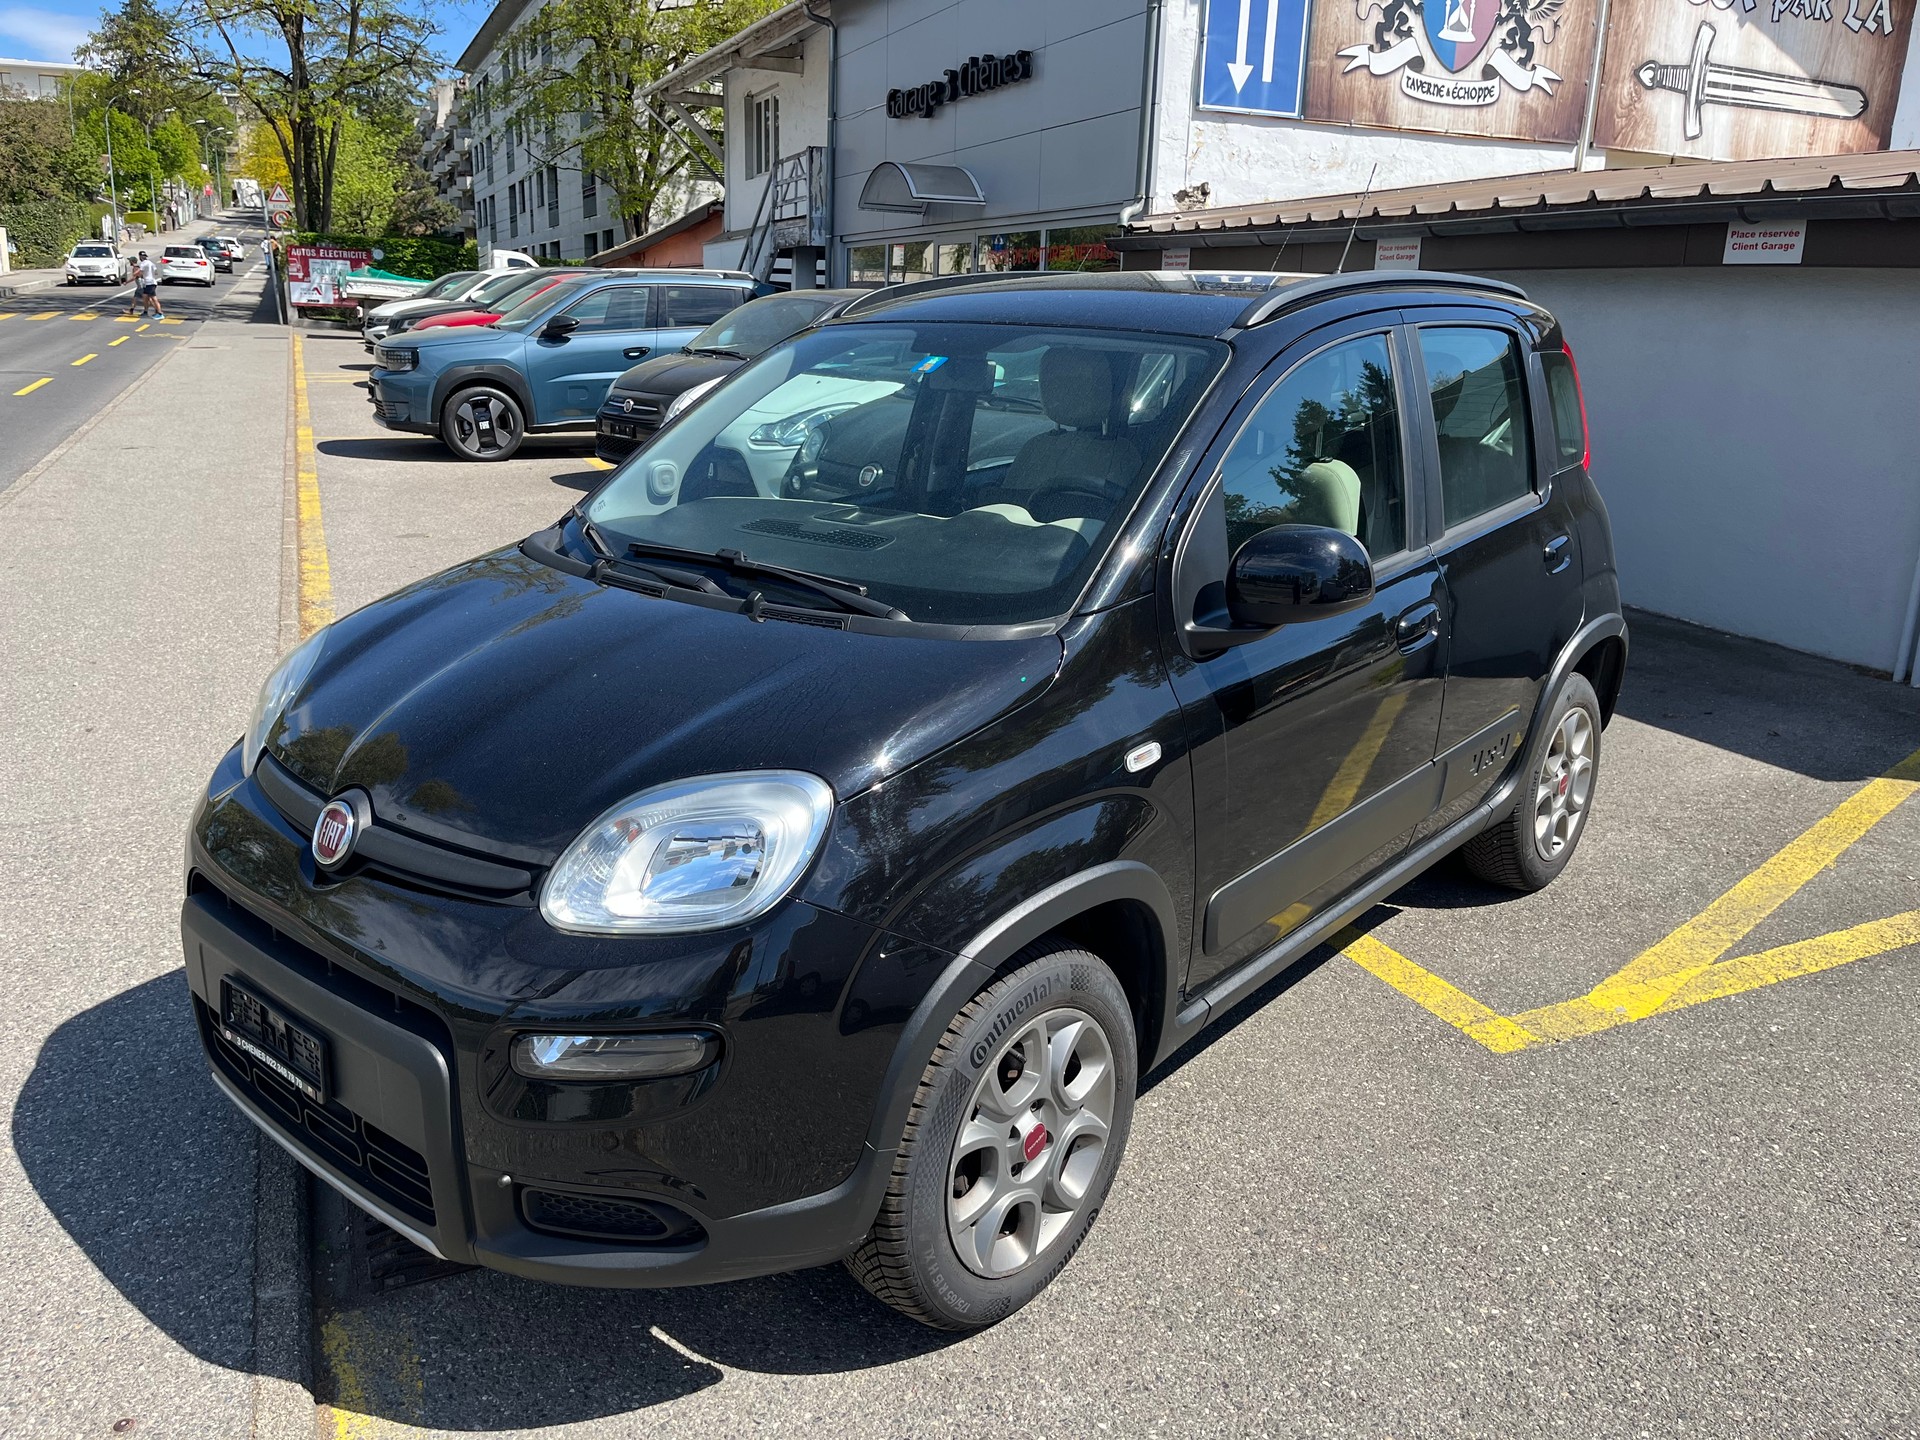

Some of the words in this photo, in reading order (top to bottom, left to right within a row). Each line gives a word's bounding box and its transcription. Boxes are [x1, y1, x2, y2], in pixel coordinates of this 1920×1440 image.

[886, 88, 944, 119] Garage
[943, 69, 958, 101] 3
[958, 50, 1033, 96] Chênes
[1406, 76, 1445, 97] TAVERNE
[1452, 82, 1495, 103] ÉCHOPPE
[1731, 230, 1756, 239] Place
[1758, 228, 1801, 238] réservée
[291, 248, 316, 256] AUTOS
[320, 249, 368, 259] ELECTRICITE
[1732, 242, 1758, 251] Client
[1761, 241, 1796, 252] Garage
[318, 816, 345, 851] FIAT
[969, 976, 1051, 1069] Continental
[928, 1262, 940, 1276] H
[938, 1282, 949, 1296] R
[944, 1290, 971, 1314] 175/65
